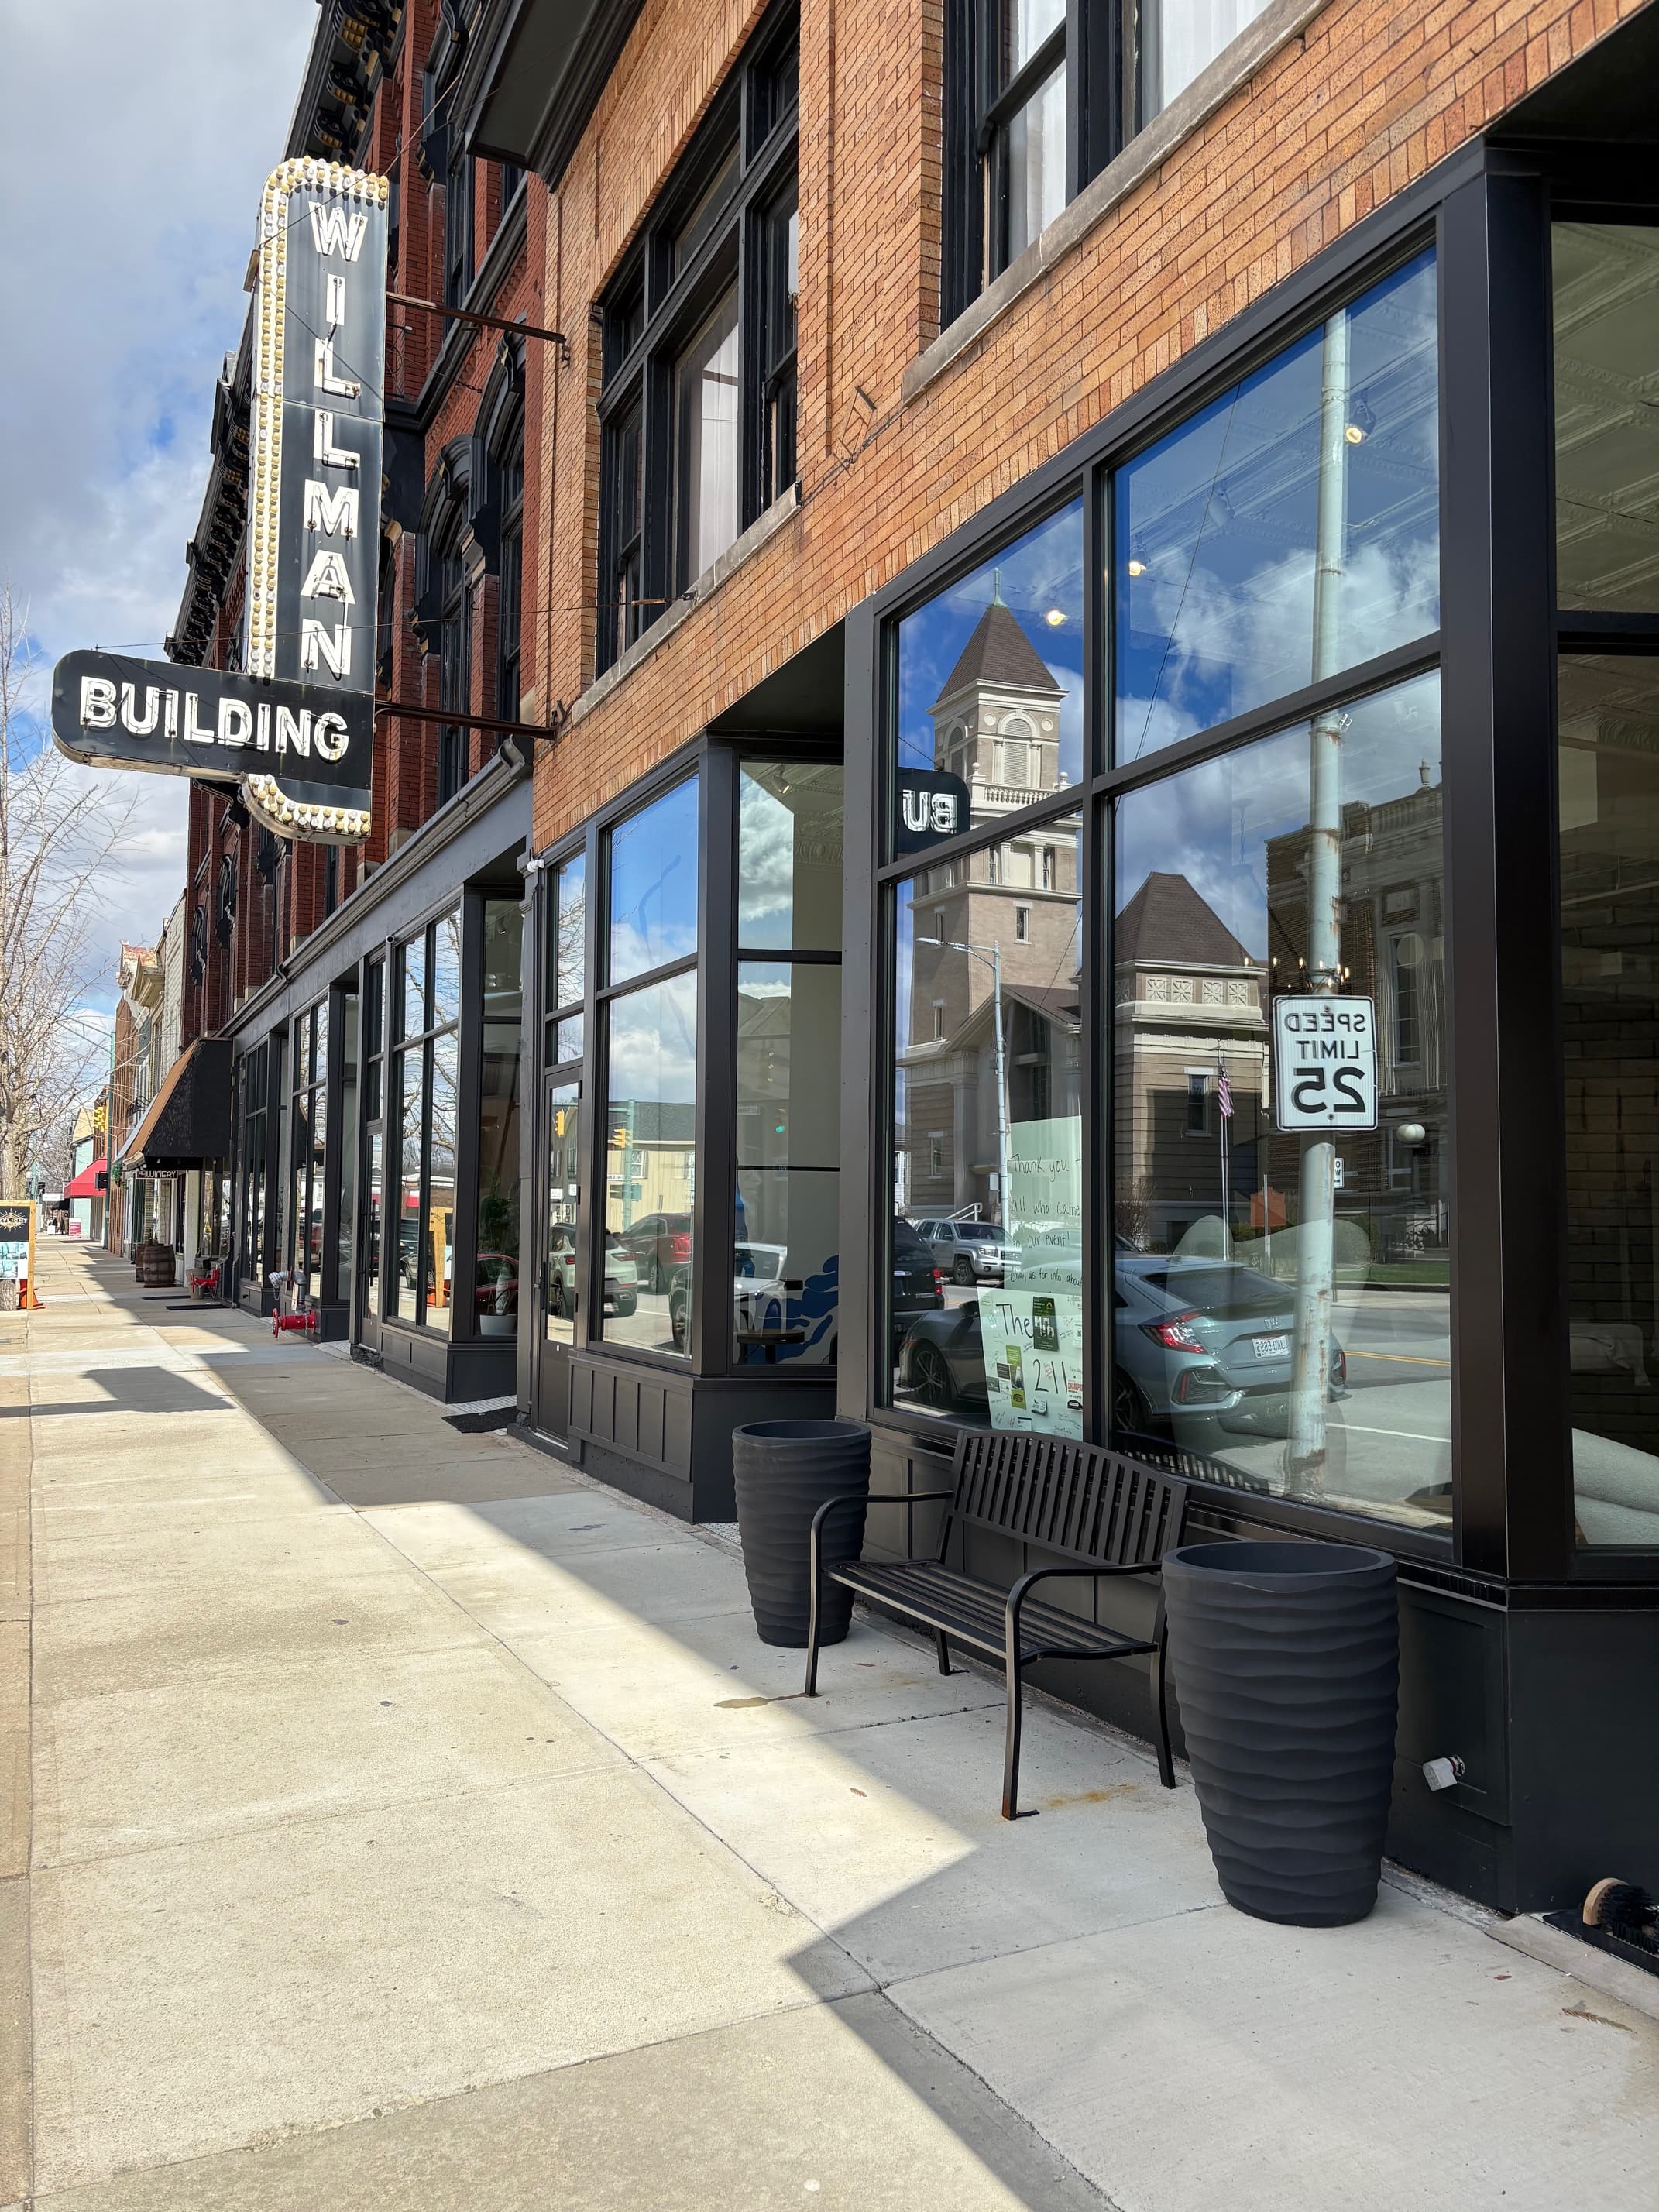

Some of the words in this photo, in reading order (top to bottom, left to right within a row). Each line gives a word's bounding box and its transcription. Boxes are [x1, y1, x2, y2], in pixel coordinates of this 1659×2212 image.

[301, 201, 368, 675] WILLMAN
[80, 675, 349, 761] BUILDING
[1010, 1153, 1045, 1174] Thank
[1049, 1159, 1070, 1183] you
[1012, 1195, 1025, 1212] all
[1033, 1200, 1049, 1214] who
[1056, 1201, 1081, 1217] came
[1028, 1235, 1042, 1249] our
[1045, 1231, 1070, 1247] event!
[1010, 1270, 1027, 1283] email
[1028, 1270, 1036, 1280] us
[1039, 1267, 1048, 1280] for
[1050, 1268, 1062, 1281] info
[996, 1303, 1033, 1338] The
